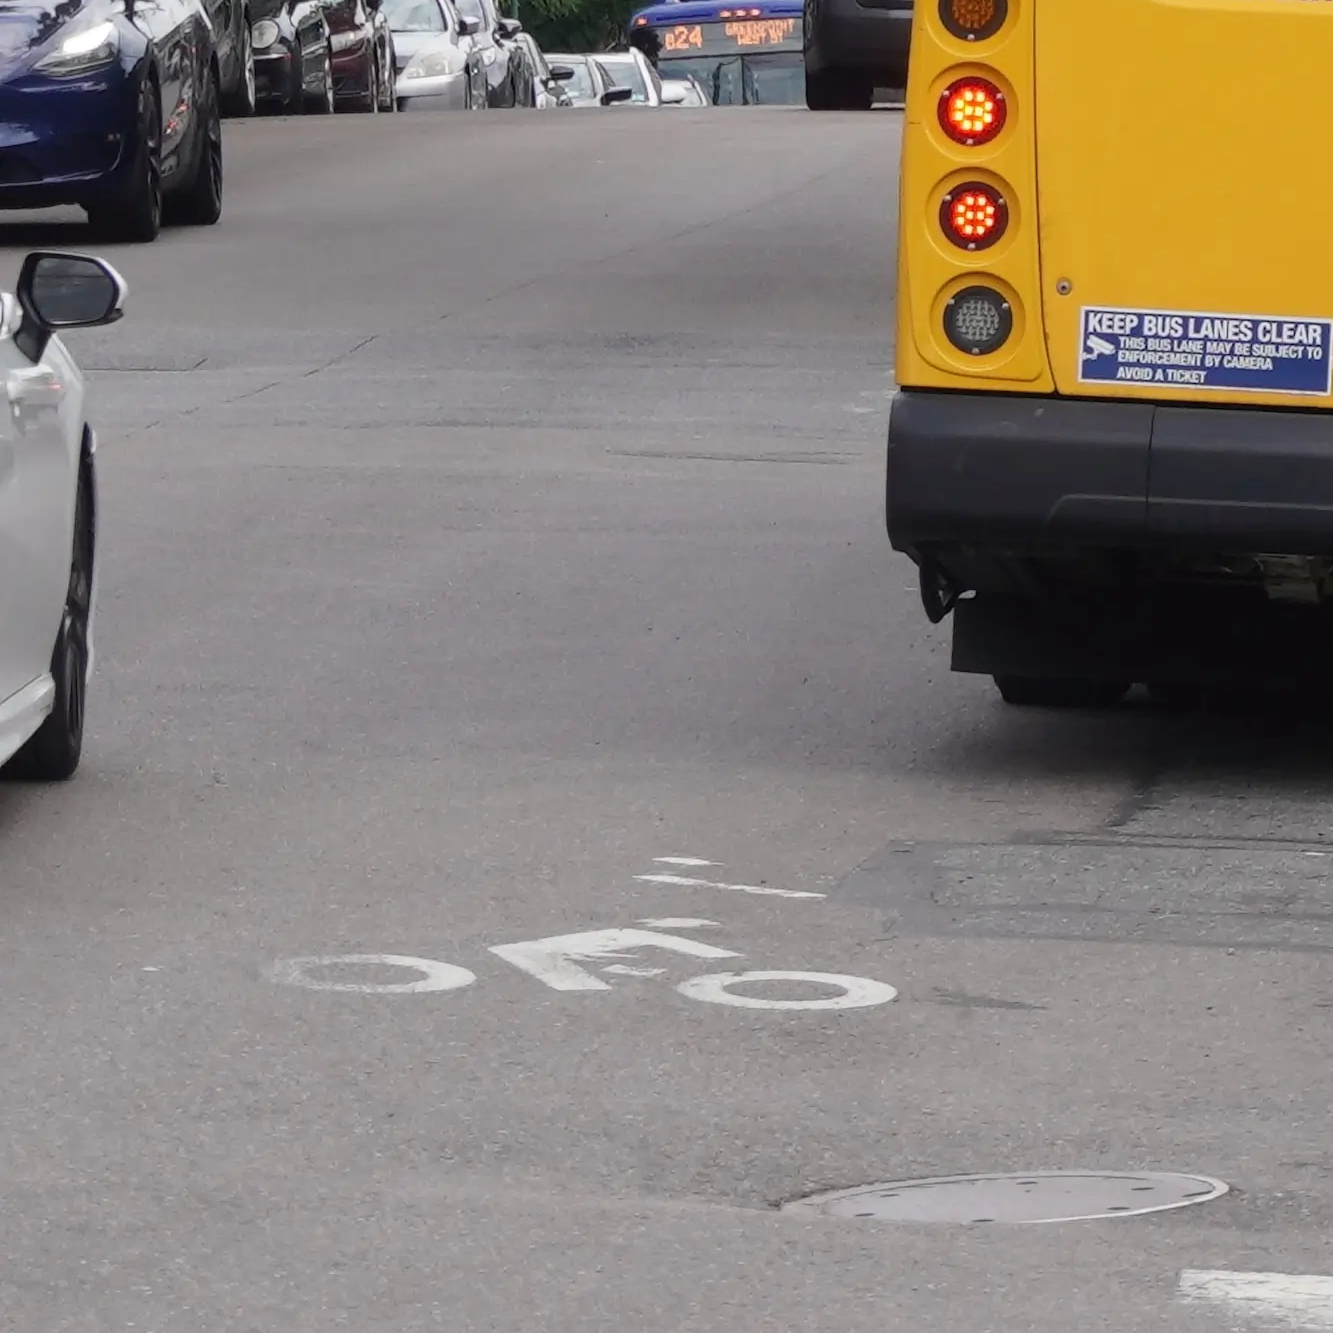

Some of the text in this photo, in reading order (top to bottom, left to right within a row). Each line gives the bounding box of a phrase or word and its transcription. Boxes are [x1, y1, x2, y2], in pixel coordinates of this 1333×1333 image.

[664, 24, 702, 50] B24
[1088, 313, 1321, 345] KEEP BUS LANES CLEAR
[1117, 350, 1273, 370] ENFORCEMENT BY CAMERA
[1120, 336, 1322, 360] THIS BUS LANE MAY BE SUBJECT TO
[1116, 367, 1207, 383] AVOID A TICKET
